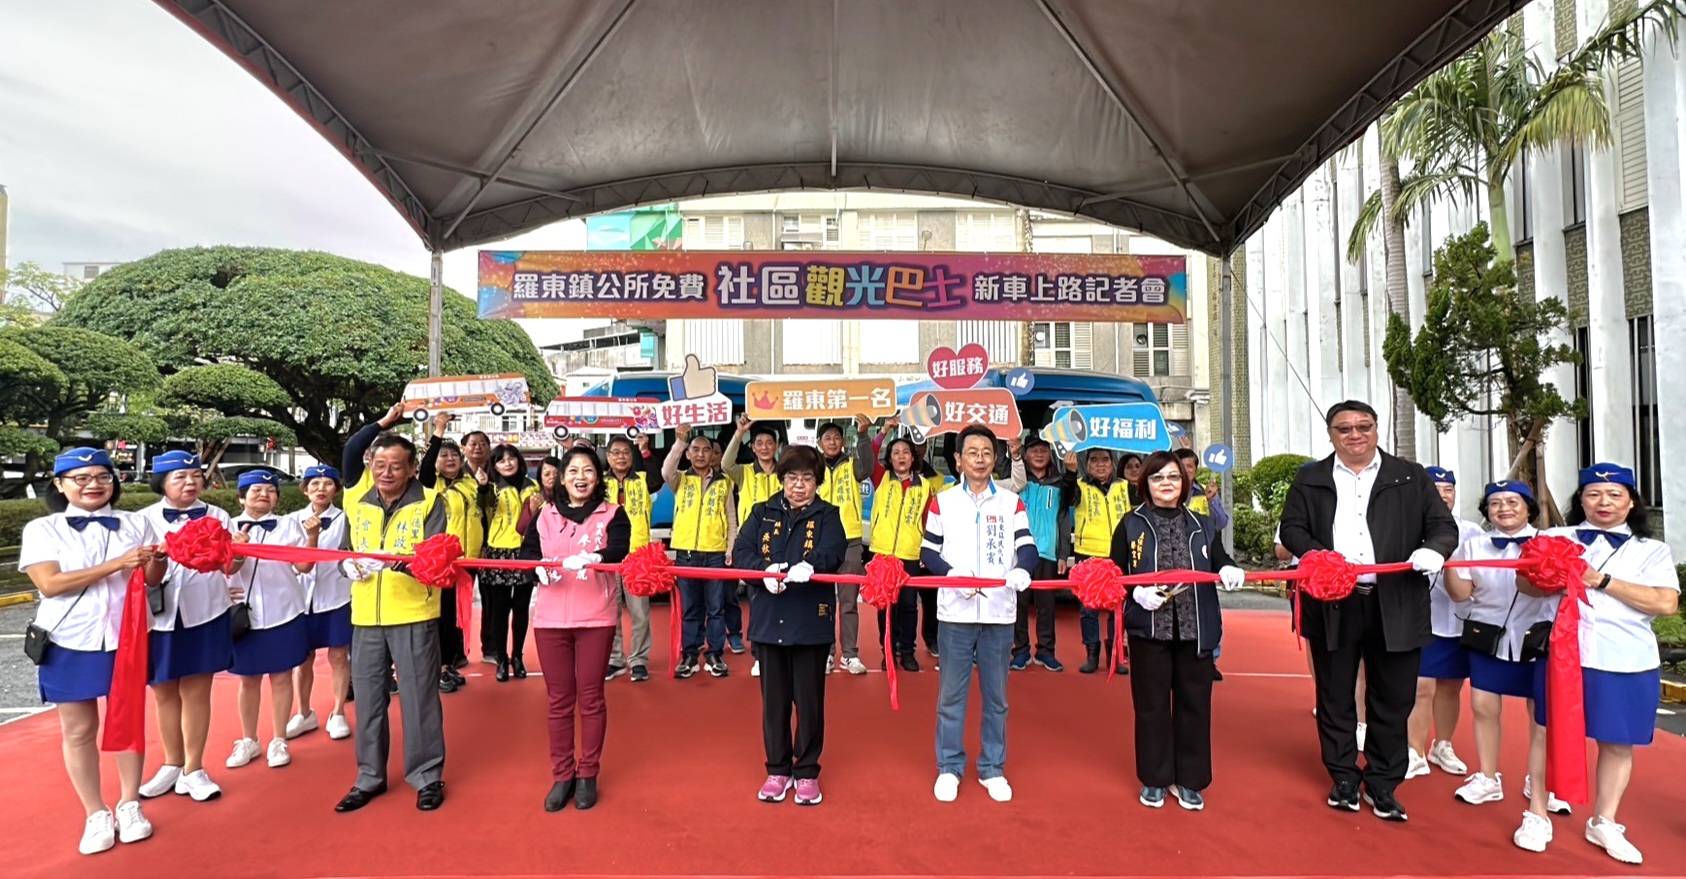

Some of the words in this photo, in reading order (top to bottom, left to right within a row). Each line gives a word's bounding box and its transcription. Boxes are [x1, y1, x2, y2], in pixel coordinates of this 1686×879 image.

[513, 272, 705, 300] 羅東鎮公所免費
[717, 264, 961, 308] 社區觀光巴士
[974, 274, 1167, 303] 新車上路記者會
[931, 357, 984, 378] 好服務
[783, 387, 892, 412] 羅東第一名
[661, 401, 728, 426] 好生活
[944, 401, 1010, 425] 好交通
[1089, 416, 1157, 440] 好福利
